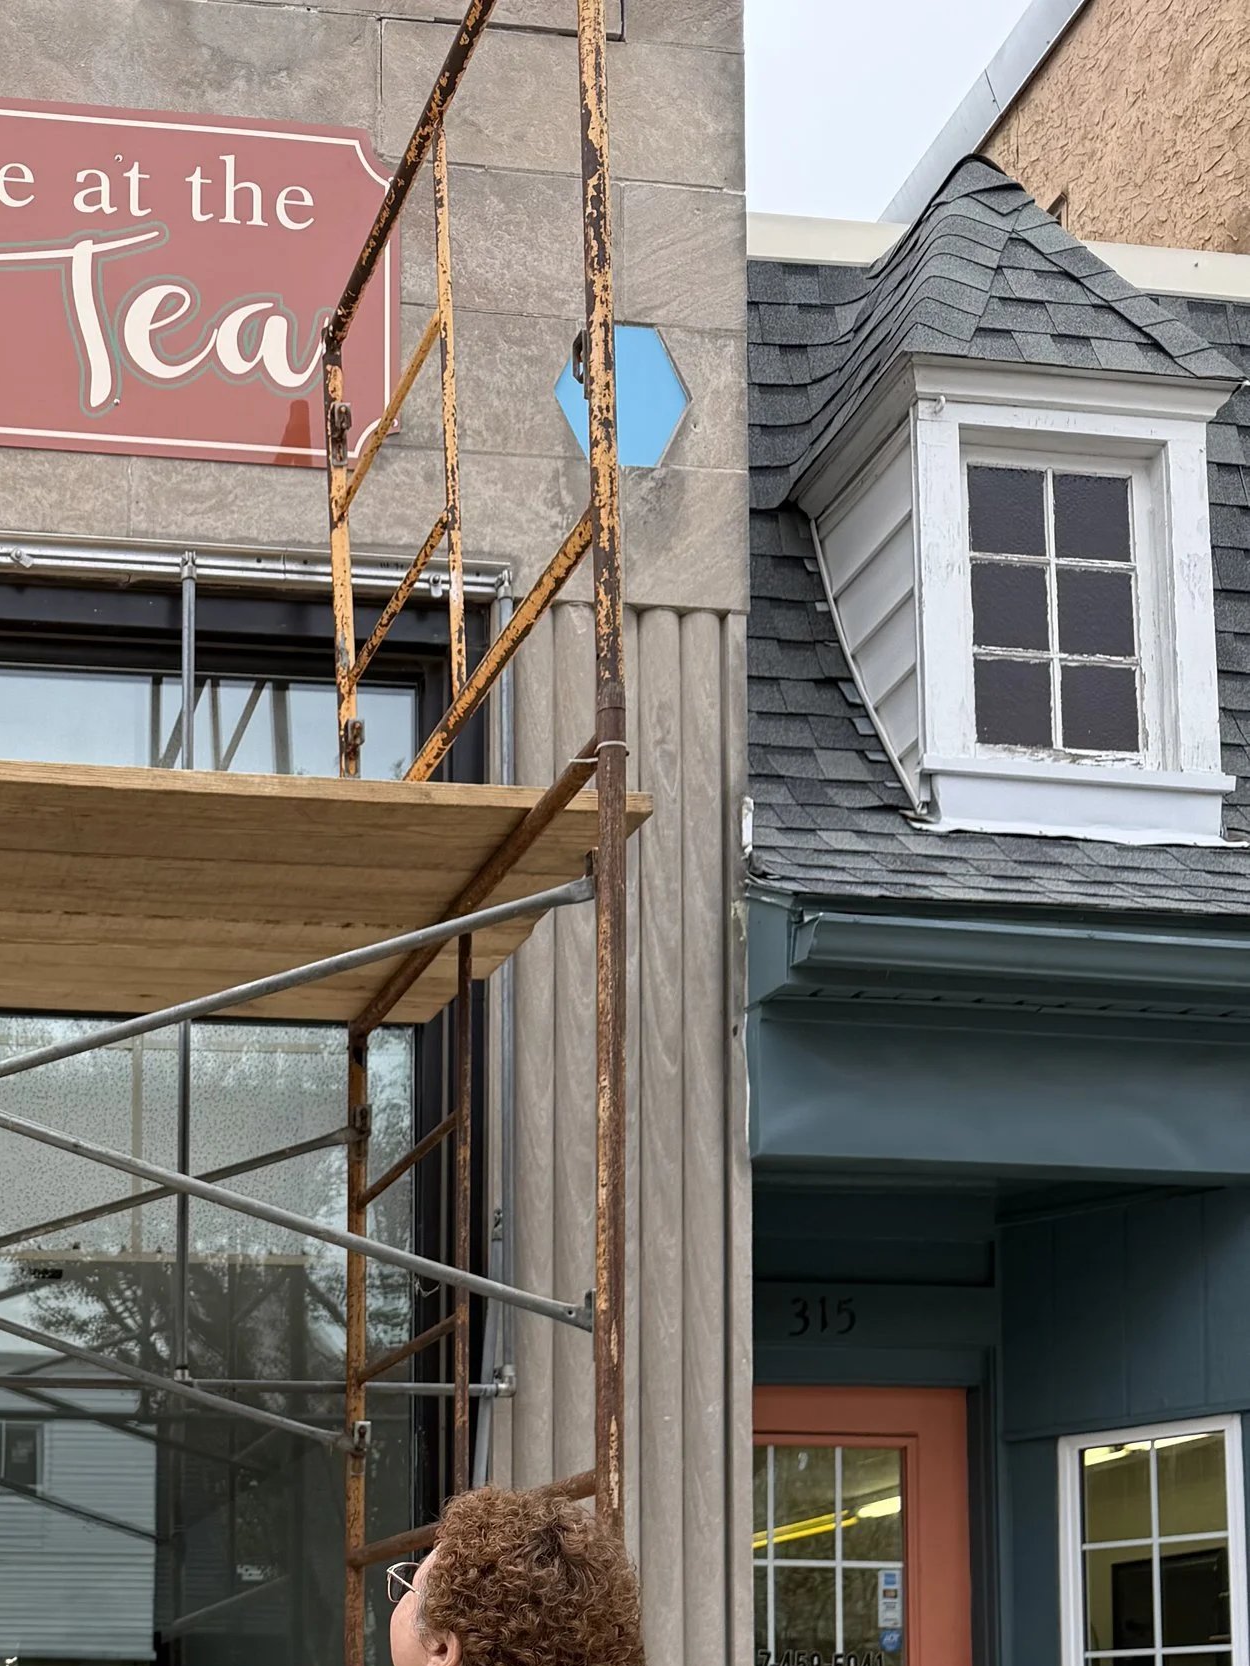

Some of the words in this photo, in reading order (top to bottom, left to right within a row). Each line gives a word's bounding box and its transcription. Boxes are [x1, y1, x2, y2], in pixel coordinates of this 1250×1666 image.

[73, 160, 152, 217] at
[185, 154, 315, 231] the
[789, 1296, 856, 1336] 315
